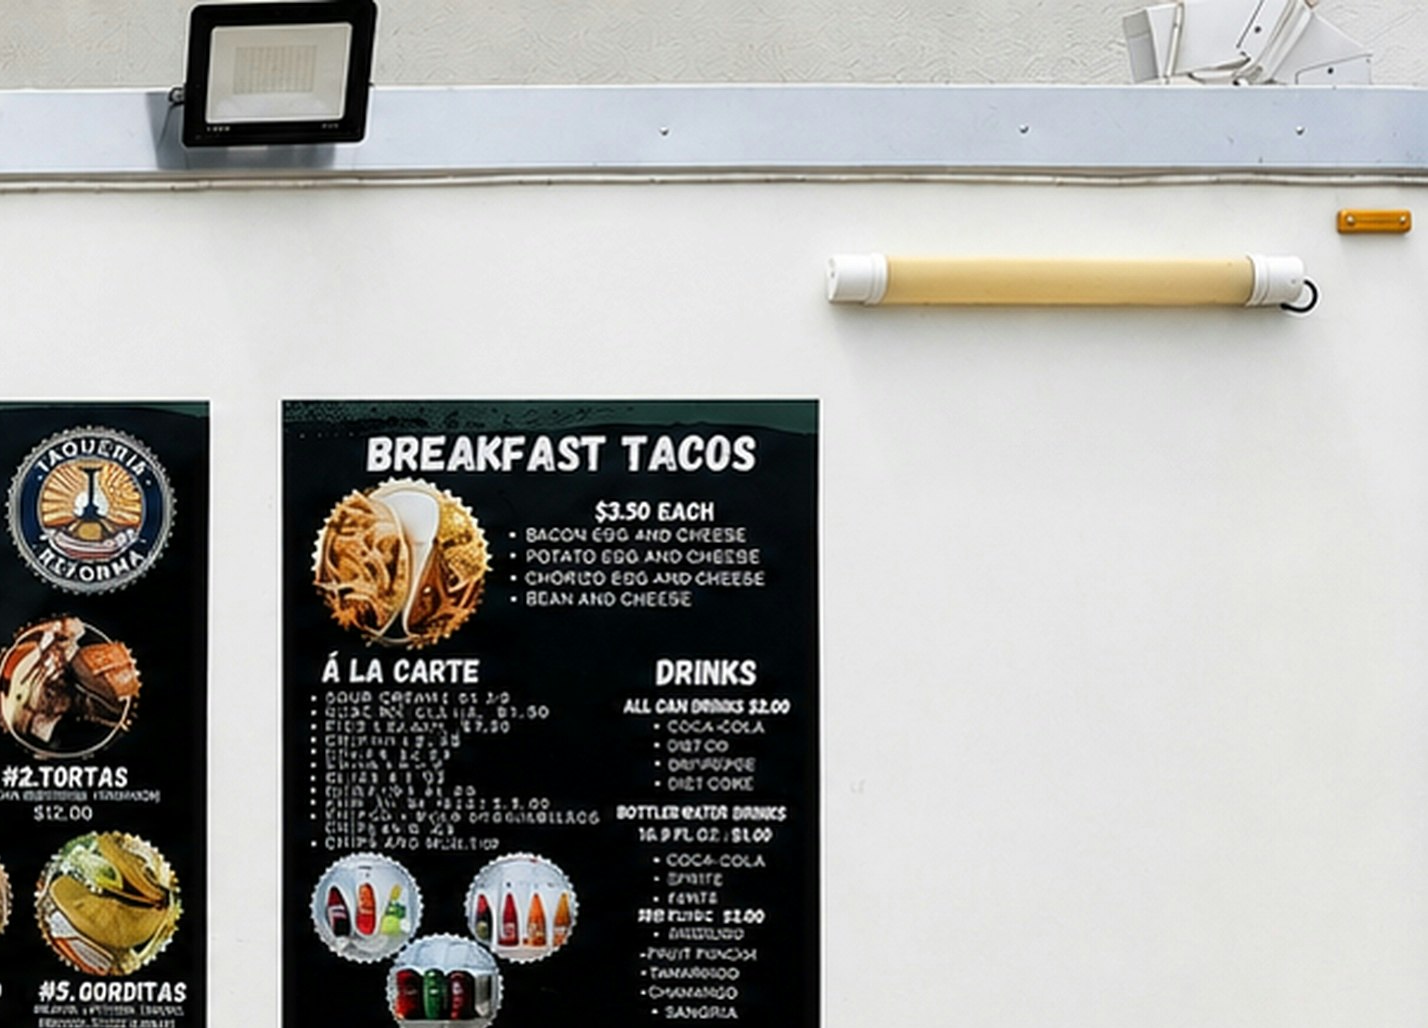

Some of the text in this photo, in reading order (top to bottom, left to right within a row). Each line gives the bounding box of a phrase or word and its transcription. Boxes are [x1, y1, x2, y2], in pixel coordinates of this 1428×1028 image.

[366, 435, 756, 472] BREAKFAST TACOS
[594, 500, 715, 524] $3.50 EACH
[525, 527, 587, 544] BACON
[635, 527, 671, 543] AND
[676, 527, 747, 544] CHEESE
[525, 549, 596, 565] POTATO
[645, 549, 683, 565] AND
[686, 549, 760, 565] CHEESE
[524, 570, 606, 587] CHORIZO
[695, 571, 765, 587] CHEESE
[526, 592, 692, 607] BEAN AND CHEESE
[321, 651, 480, 683] Á LA CARTE
[655, 659, 757, 686] DRINKS
[623, 698, 652, 714] ALL
[655, 698, 688, 714] CAN
[667, 719, 765, 734] COCA-COLA
[2, 766, 129, 788] #2.TORTAS
[34, 806, 93, 822] $12.00
[666, 854, 766, 868] COCA-COLA
[79, 982, 188, 1003] GORDITAS
